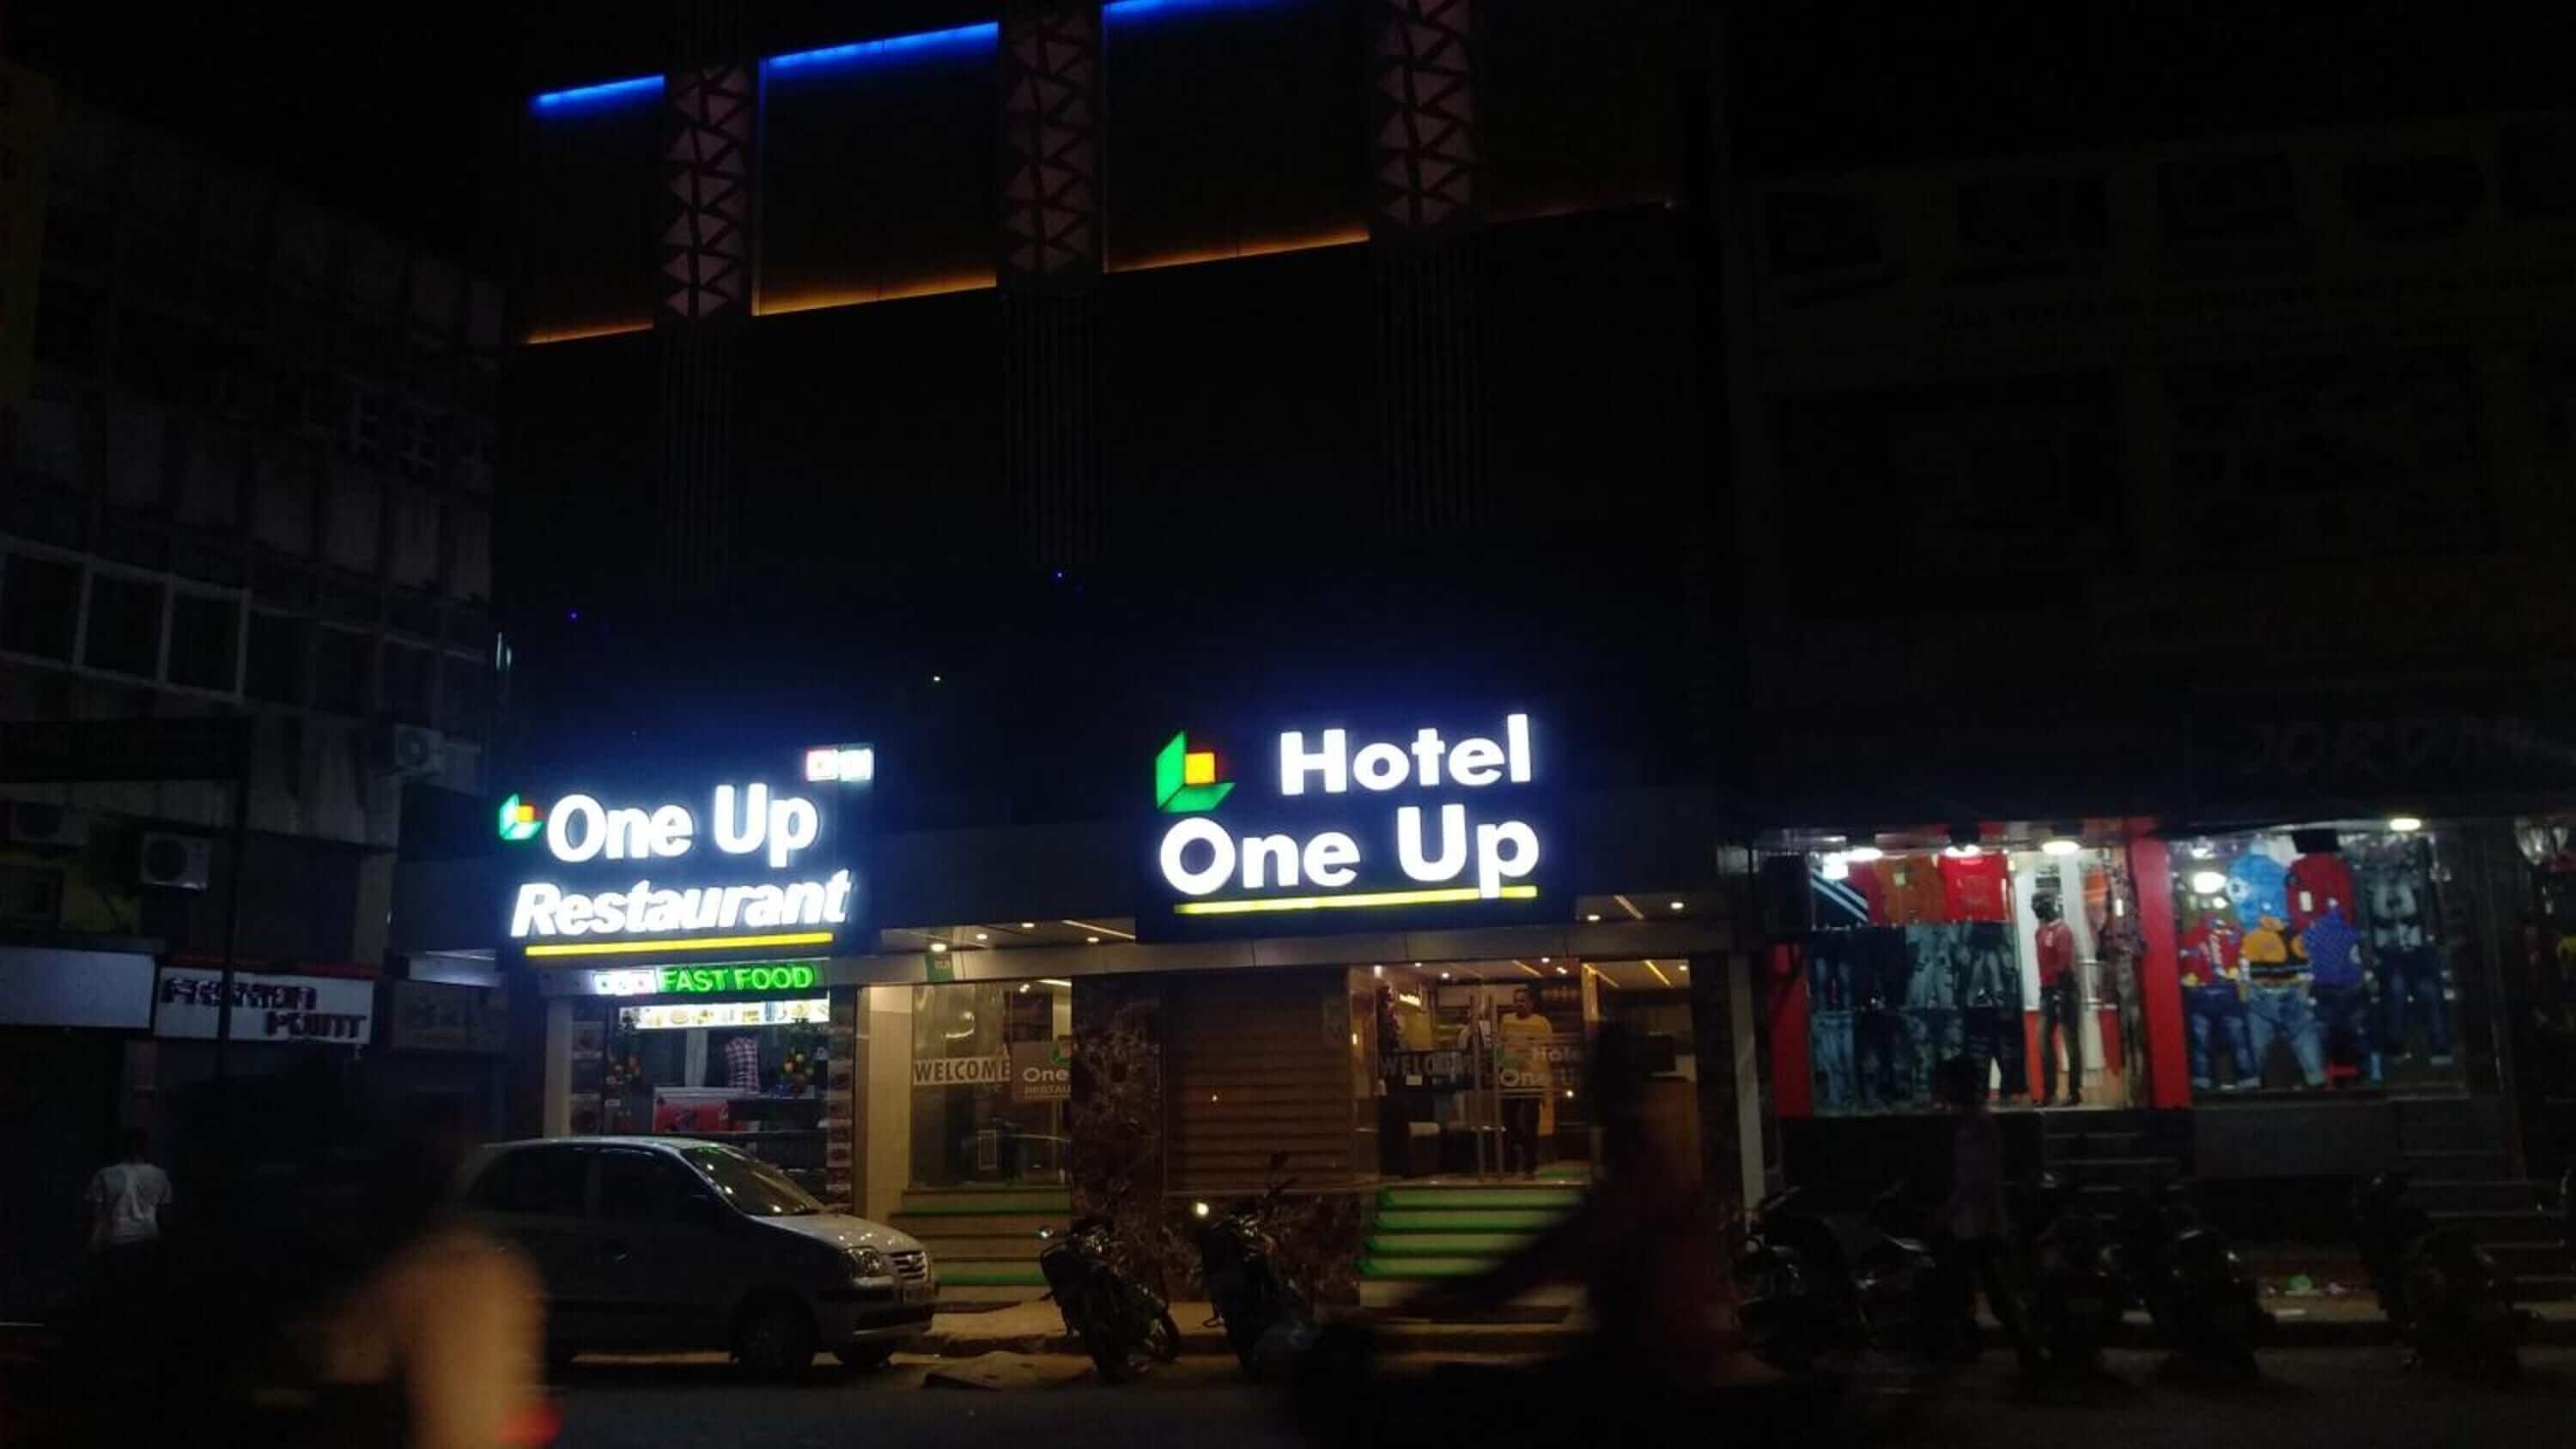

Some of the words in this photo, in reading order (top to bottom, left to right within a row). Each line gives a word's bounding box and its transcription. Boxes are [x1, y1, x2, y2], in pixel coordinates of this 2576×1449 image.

[1280, 713, 1532, 796] Hotel
[547, 794, 694, 863] One
[714, 783, 818, 868] Up
[1159, 816, 1361, 895] One
[1397, 803, 1540, 899] Up
[510, 869, 854, 937] Restaurant
[660, 969, 728, 992] FAST
[734, 967, 813, 990] FOOD
[914, 1060, 1009, 1082] WELCOME
[1023, 1067, 1070, 1083] One
